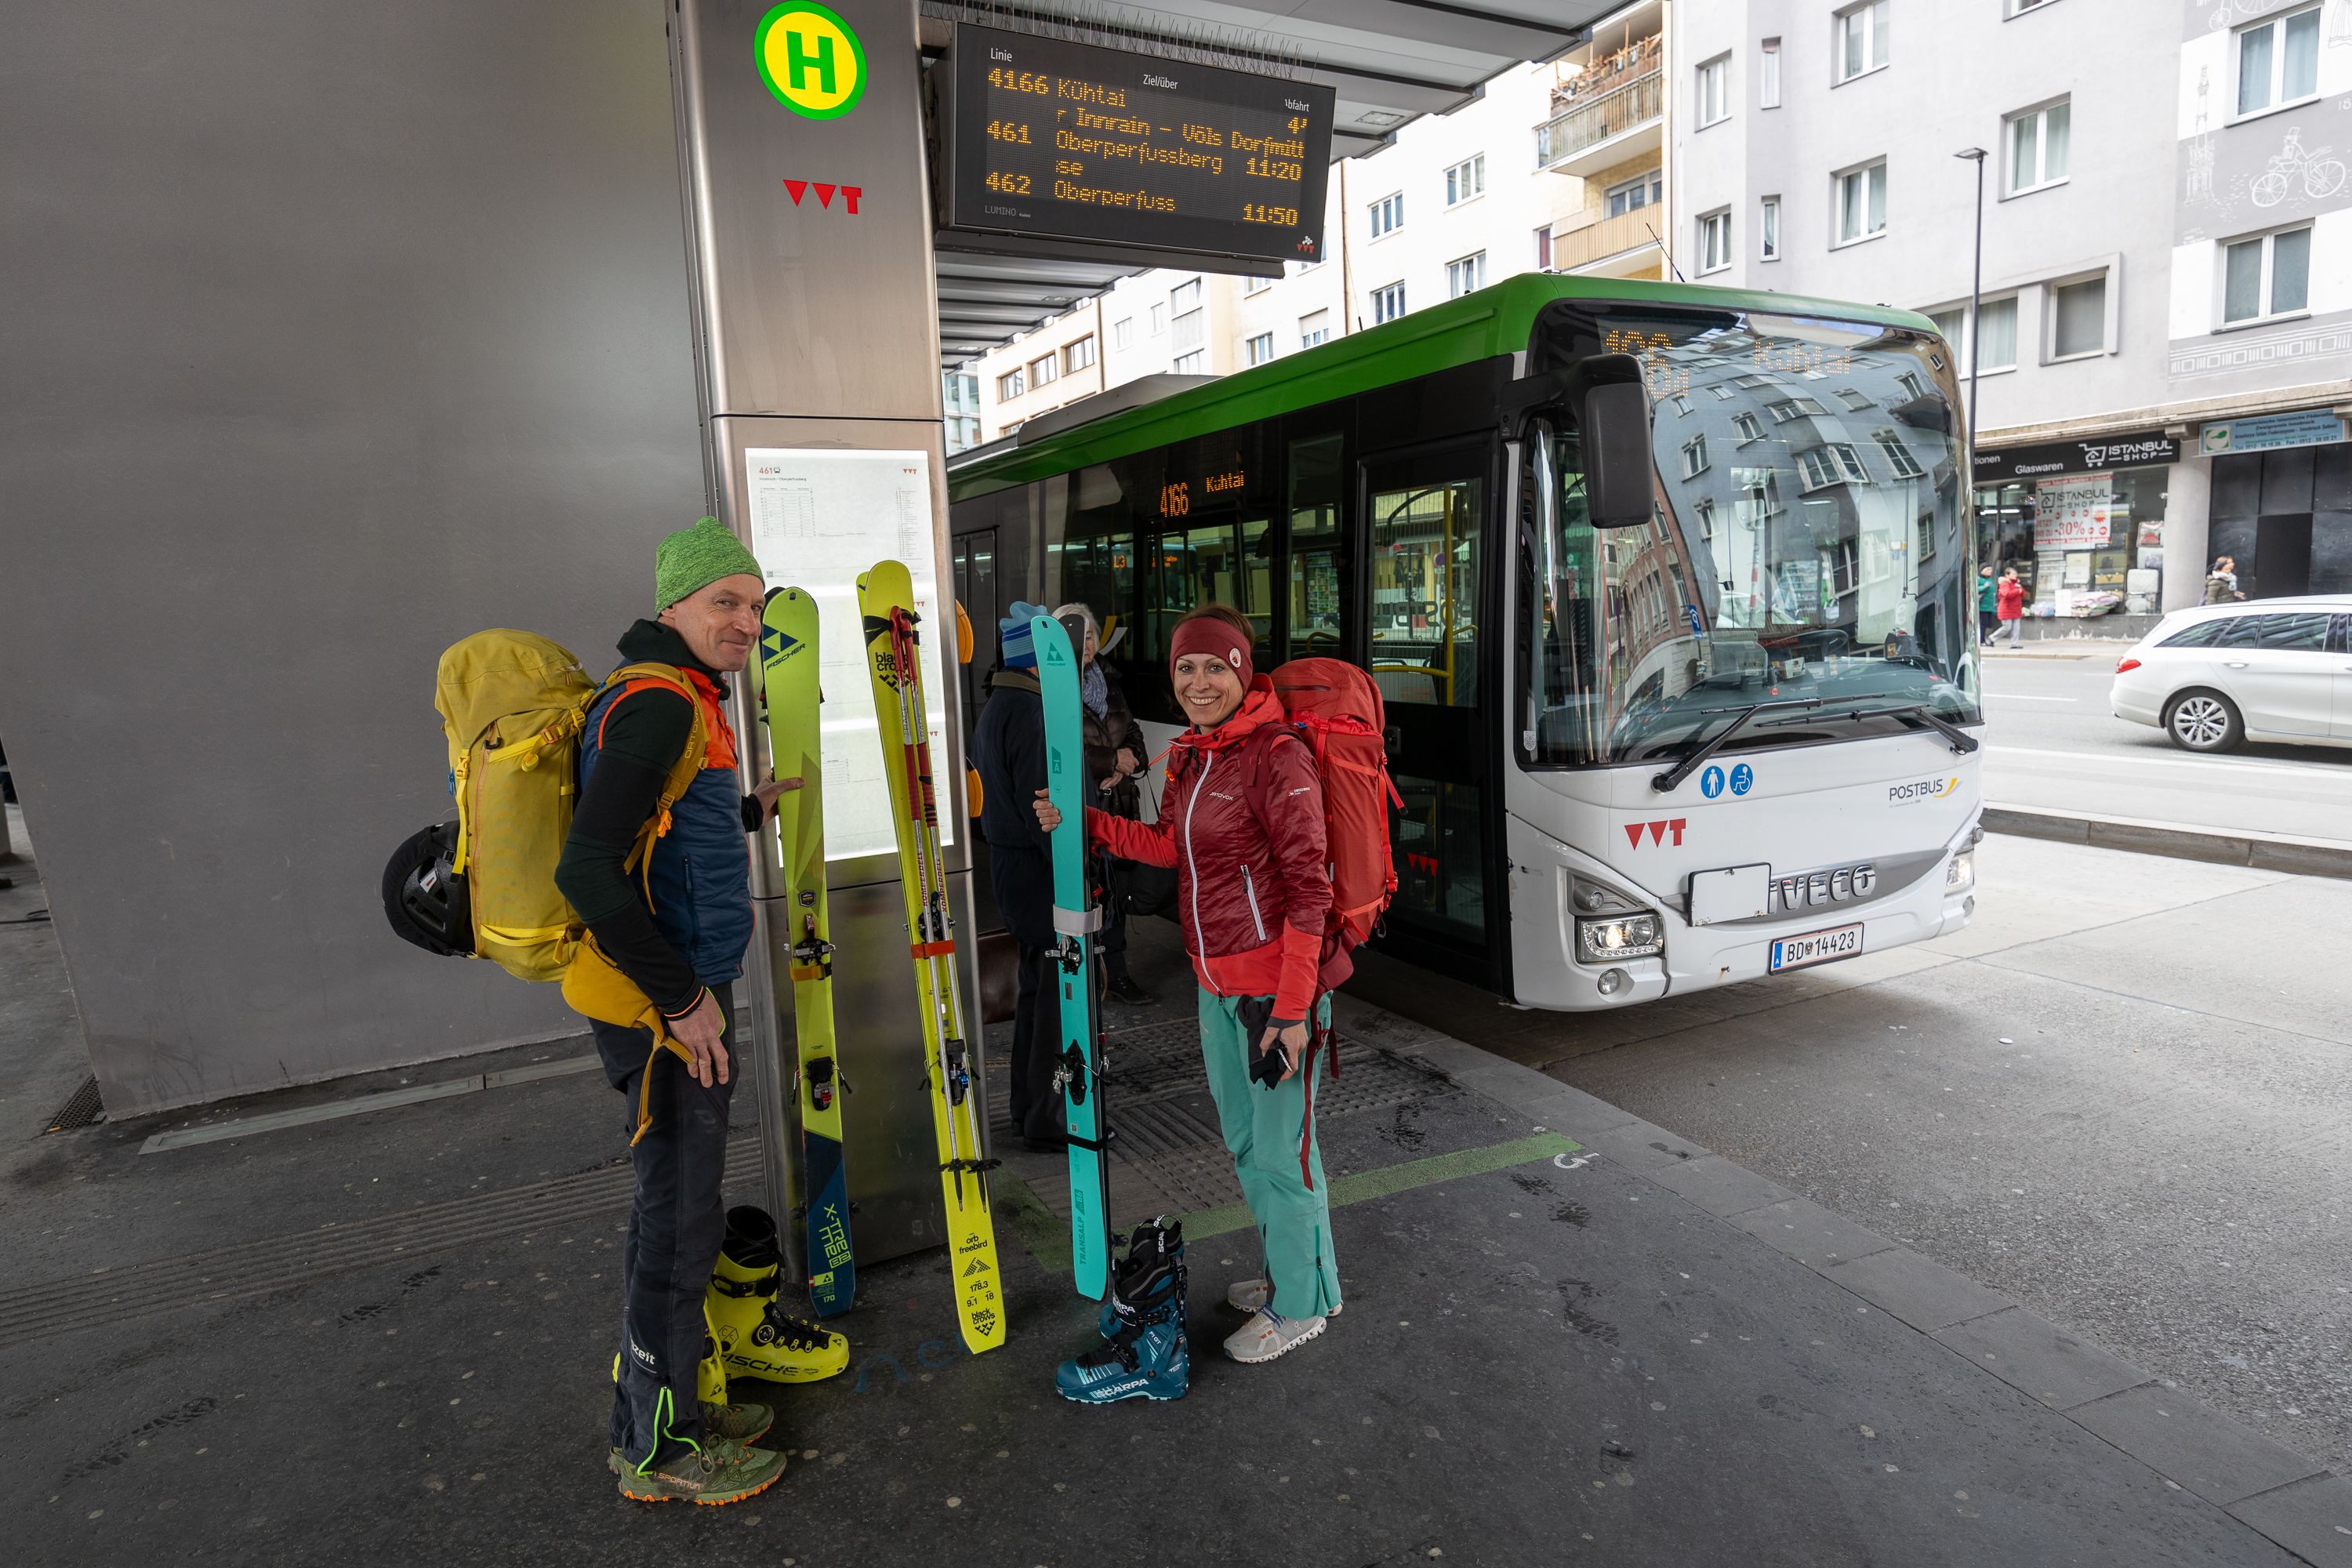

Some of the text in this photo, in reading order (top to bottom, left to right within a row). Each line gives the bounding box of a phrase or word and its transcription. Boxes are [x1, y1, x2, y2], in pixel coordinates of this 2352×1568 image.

[786, 30, 837, 95] H
[989, 47, 1013, 62] Linie
[988, 67, 1049, 95] 4166
[1058, 78, 1126, 107] Kühtai
[1142, 74, 1178, 89] Ziel/über
[1076, 107, 1150, 136] Innrain
[1182, 123, 1223, 147] Völs
[1231, 131, 1305, 158] Dorfmitt
[987, 120, 1301, 181] 461 Oberperfussberg 11:20
[782, 179, 862, 215] VVT
[985, 172, 1298, 226] 462 Oberperfuss 11:50
[985, 205, 1017, 216] LUMINO
[1755, 341, 1851, 375] Kühtai
[2107, 440, 2174, 456] ISTANBUL
[2122, 451, 2157, 462] SHOP
[2014, 462, 2064, 474] Glaswaren
[1160, 470, 1244, 517] 4166 Kühtai
[2056, 488, 2109, 502] ISTANBUL
[2067, 499, 2094, 509] SHOP
[766, 643, 806, 671] FISCHER
[1889, 779, 1944, 801] POSTBUS
[1624, 818, 1686, 851] VVT
[1406, 852, 1439, 877] VVT
[1768, 864, 1877, 915] IVECO
[1787, 931, 1855, 963] BD 14423
[959, 1240, 988, 1254] freebird
[966, 1234, 979, 1244] orb
[1076, 1216, 1087, 1265] TRANSALP
[969, 1280, 989, 1292] 178.3
[823, 1294, 836, 1303] 170
[966, 1298, 978, 1308] 9.1
[985, 1292, 995, 1301] 18
[971, 1308, 991, 1319] black
[972, 1312, 996, 1325] crows
[1095, 1378, 1149, 1398] SCARPA
